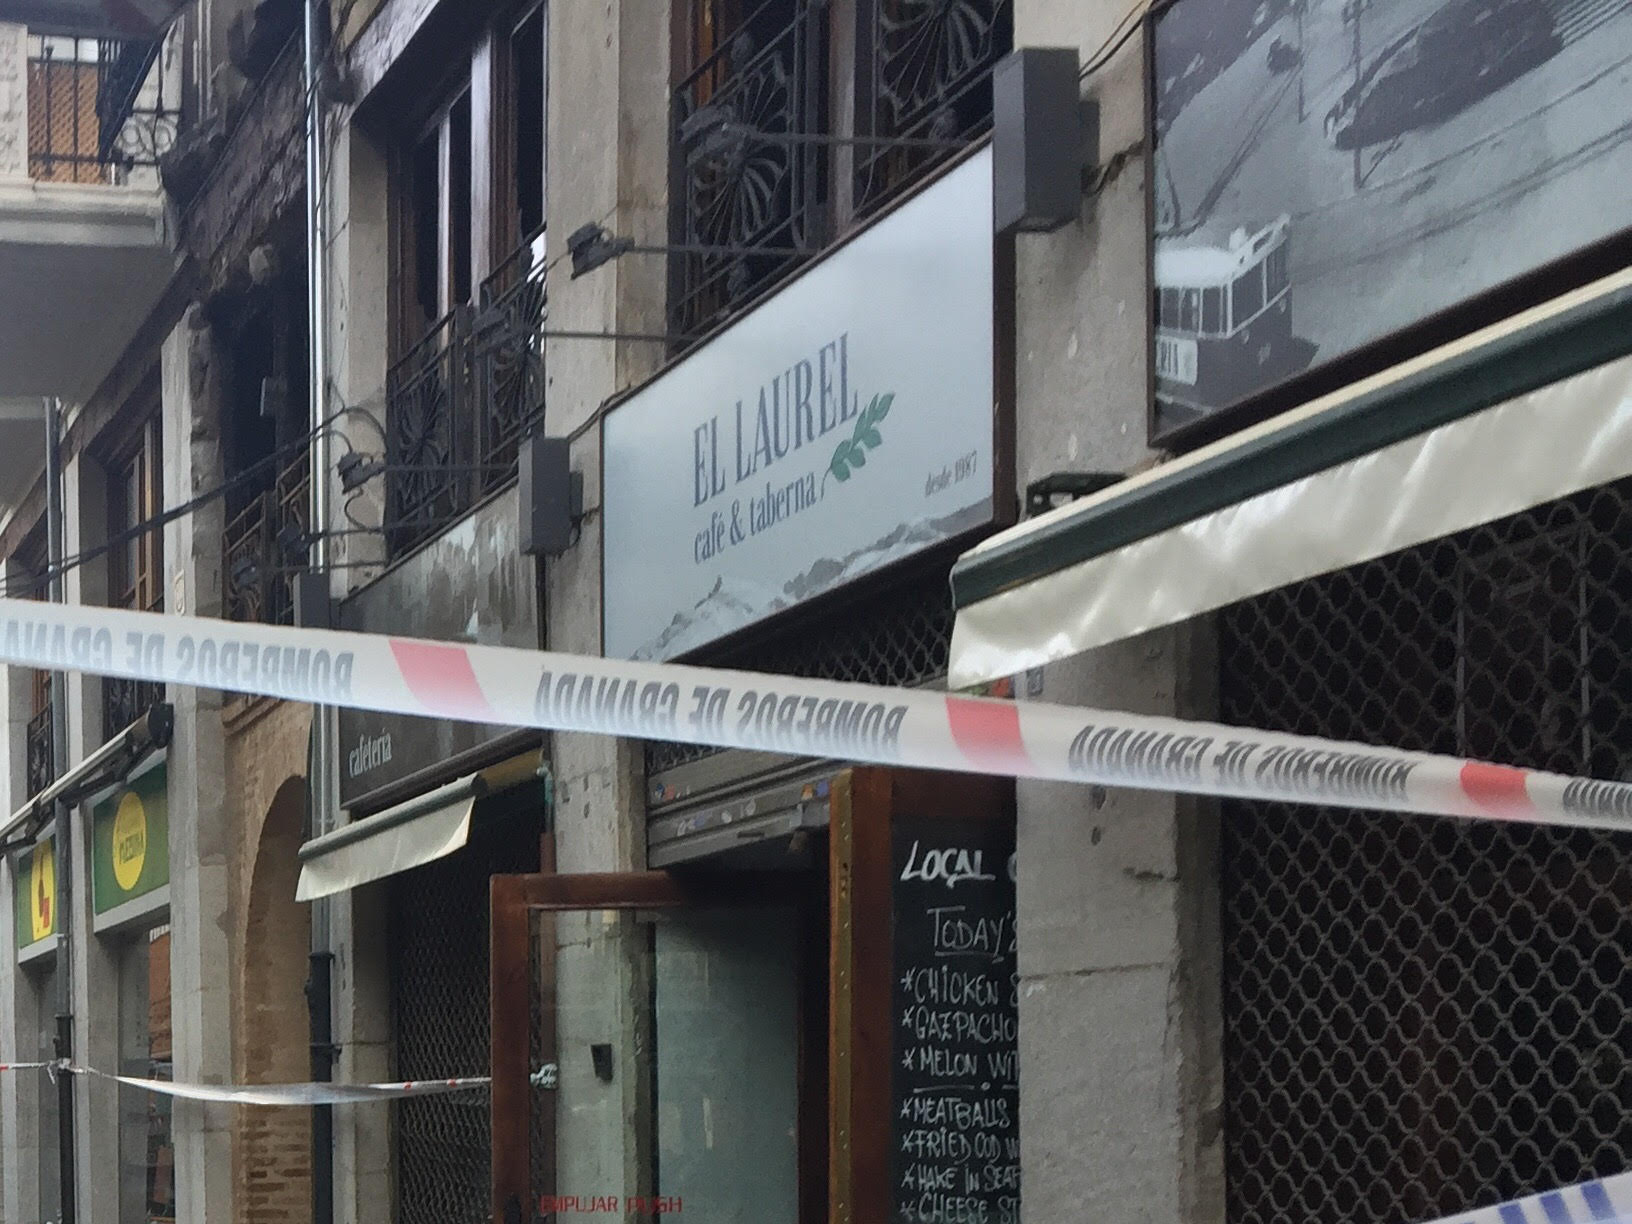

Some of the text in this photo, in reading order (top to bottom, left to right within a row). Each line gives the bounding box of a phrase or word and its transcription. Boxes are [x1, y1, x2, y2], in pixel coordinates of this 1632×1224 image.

[694, 331, 858, 507] EL LAUREL
[694, 472, 817, 564] café & taberna
[349, 727, 392, 778] cafetería
[900, 840, 996, 888] LOCAL
